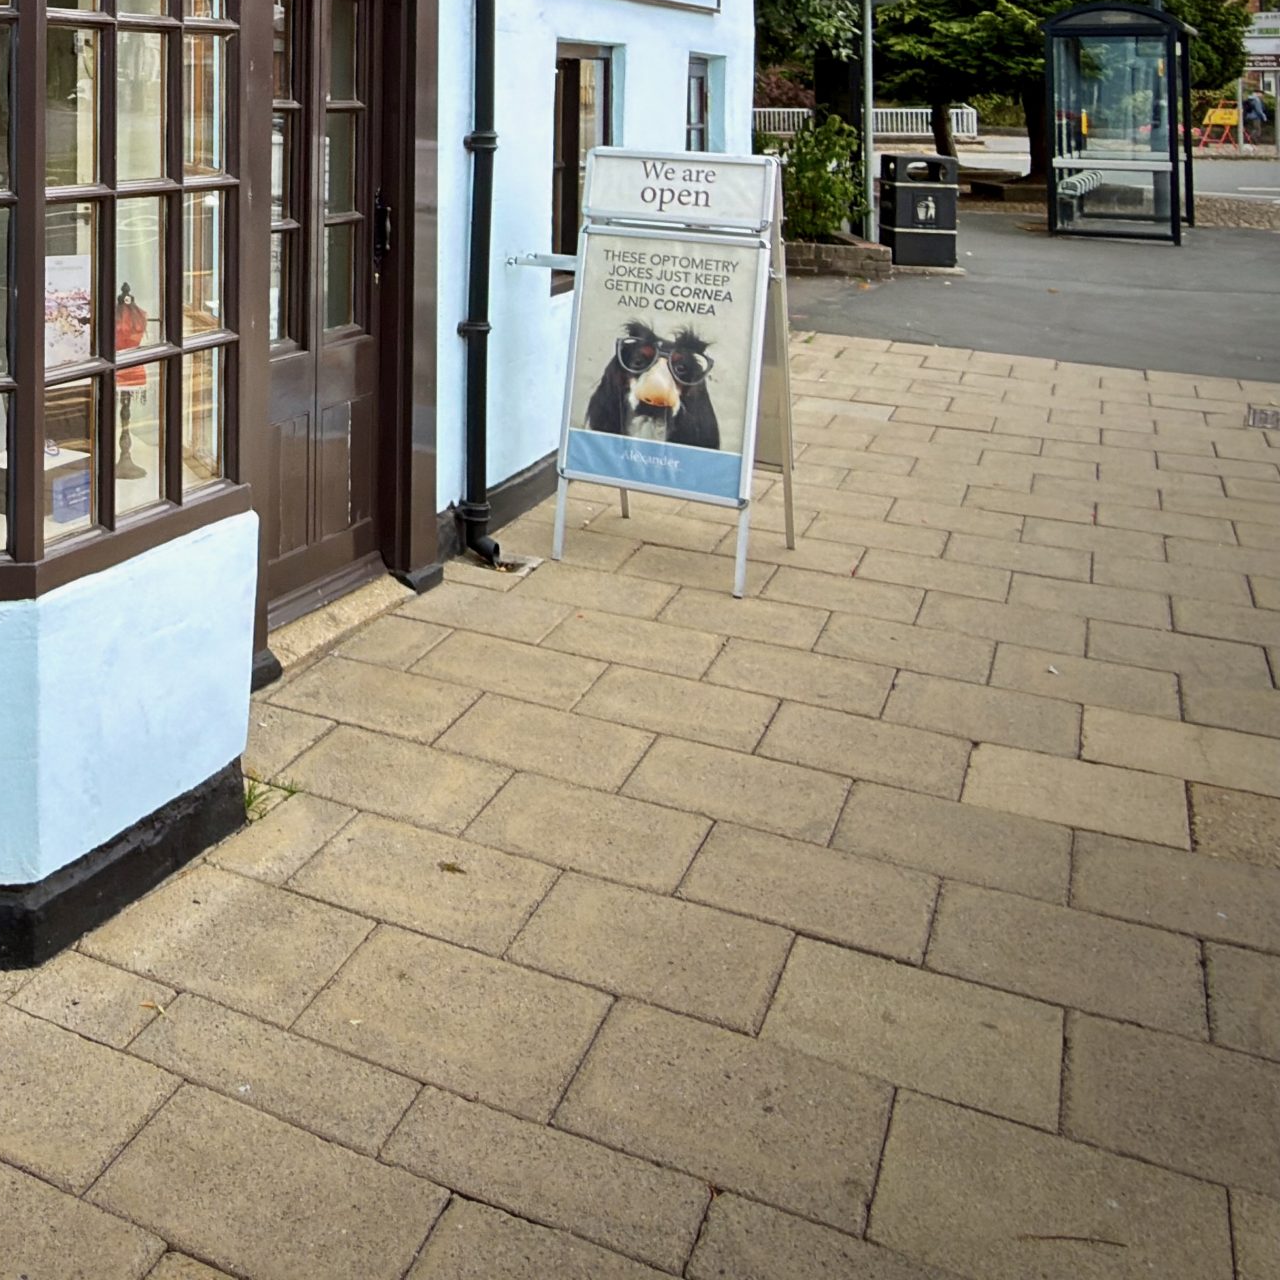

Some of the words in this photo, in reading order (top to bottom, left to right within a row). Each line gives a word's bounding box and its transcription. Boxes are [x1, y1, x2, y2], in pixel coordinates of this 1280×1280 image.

[641, 160, 676, 181] We
[682, 168, 716, 184] are
[640, 185, 711, 212] open
[603, 249, 647, 265] THESE
[650, 254, 740, 273] OPTOMETRY
[608, 265, 653, 280] JOKES
[656, 270, 692, 284] JUST
[695, 272, 731, 287] KEEP
[604, 279, 665, 296] GETTING
[670, 285, 733, 303] CORNEA
[617, 295, 650, 308] AND
[654, 298, 716, 316] CORNEA
